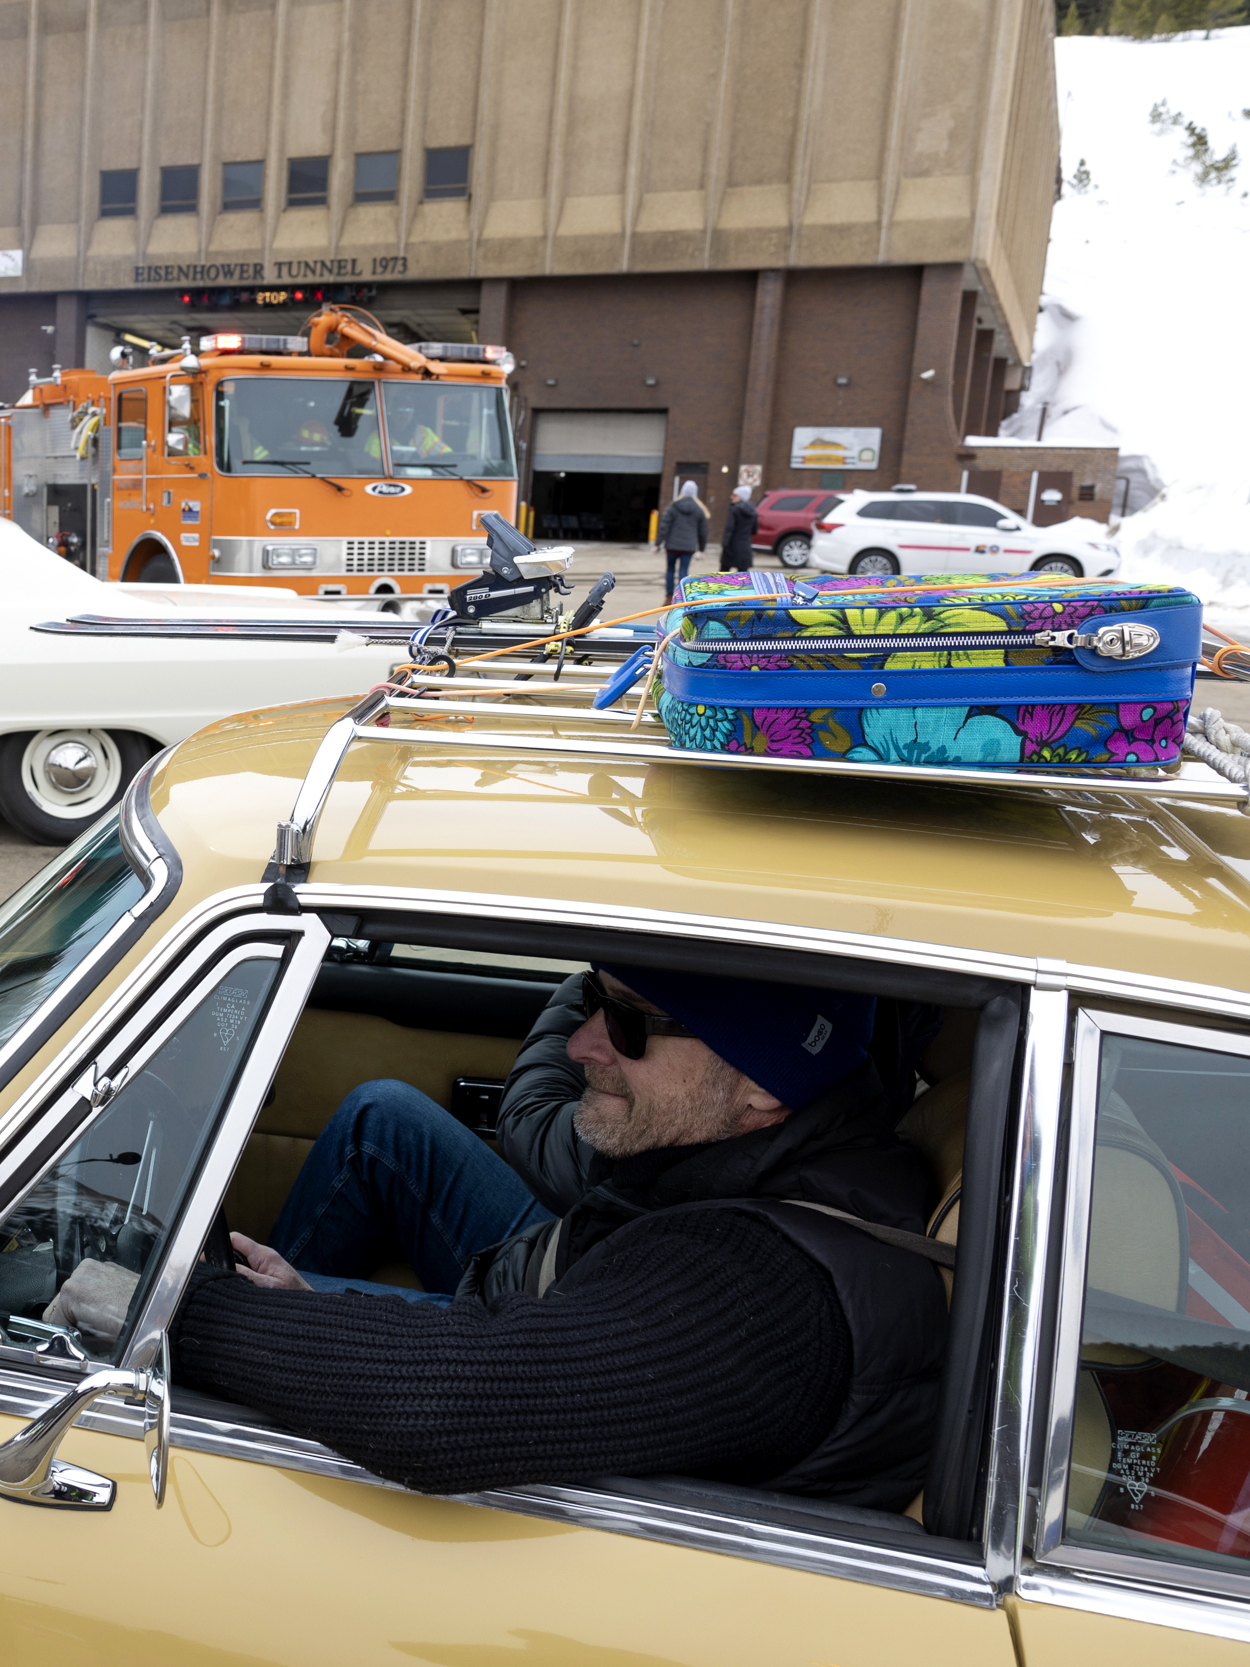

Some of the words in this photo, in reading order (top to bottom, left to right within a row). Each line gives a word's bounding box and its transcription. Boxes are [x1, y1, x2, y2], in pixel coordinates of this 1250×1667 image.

[134, 263, 264, 283] EISENHOWER
[275, 259, 362, 280] TUNNEL
[371, 256, 408, 276] 1973
[256, 291, 288, 305] STOP
[467, 594, 483, 602] 280
[214, 994, 250, 1005] CLIMAGLASS
[217, 1006, 245, 1016] TEMPERED
[1111, 1442, 1162, 1454] CLIMAGLASS
[1112, 1462, 1129, 1470] DGM
[1118, 1457, 1156, 1467] TEMPERED
